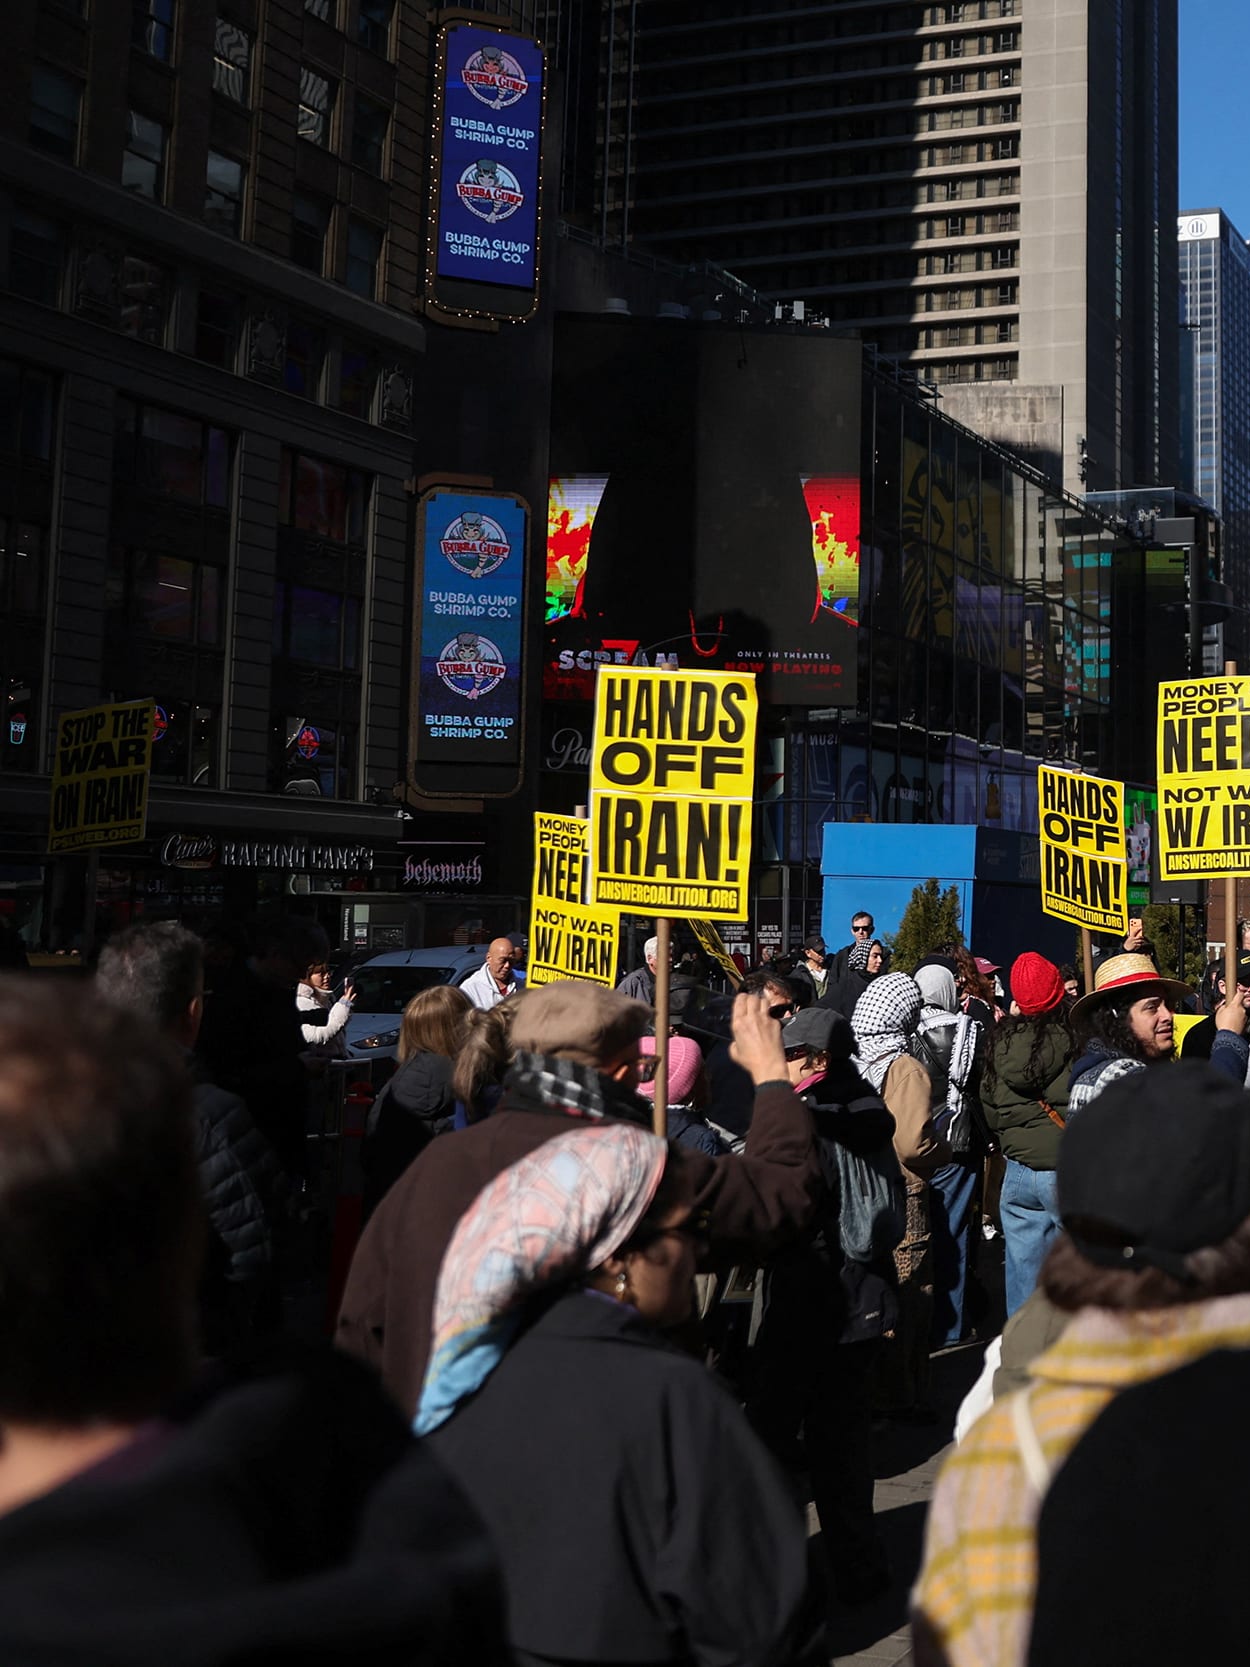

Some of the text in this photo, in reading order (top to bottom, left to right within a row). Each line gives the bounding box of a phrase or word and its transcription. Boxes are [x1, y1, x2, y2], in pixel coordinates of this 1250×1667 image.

[463, 70, 529, 93] BUBBA GUMP
[450, 116, 535, 140] BUBBA GUMP
[455, 129, 529, 151] SHRIMP CO.
[459, 184, 523, 206] BUBBA GUMP
[445, 231, 530, 254] BUBBA GUMP
[450, 243, 524, 265] SHRIMP CO.
[442, 540, 509, 556] BUBBA GUMP
[429, 591, 517, 607] BUBBA GUMP
[434, 604, 511, 618] SHRIMP CO.
[558, 649, 679, 670] SCREAM
[737, 650, 763, 658] ONLY
[784, 651, 831, 660] THEATRES
[439, 662, 505, 677] BUBBA GUMP
[723, 661, 843, 675] NOW PLAYING
[1164, 682, 1244, 699] MONEY
[425, 714, 514, 728] BUBBA GUMP
[604, 678, 748, 744] HANDS
[61, 707, 150, 748] STOP THE
[430, 727, 508, 740] SHRIMP CO.
[60, 738, 146, 777] WAR
[601, 741, 745, 789] OFF
[54, 773, 144, 831] ON IRAN!
[1043, 771, 1118, 824] HANDS
[1164, 786, 1221, 804] NOT
[52, 825, 139, 848] PSLWEB.ORG
[539, 817, 588, 835] MONEY
[1043, 812, 1120, 852] OFF
[1165, 805, 1210, 849] W/
[164, 834, 216, 866] Cane's
[539, 832, 589, 853] PEOPL
[599, 797, 742, 882] IRAN!
[222, 843, 374, 872] RAISING CANE'S
[402, 854, 483, 886] behemoth
[537, 847, 590, 905] NEE
[1045, 843, 1122, 913] IRAN!
[598, 879, 739, 910] ANSWERCOALITION.ORG
[536, 908, 614, 938] NOT WAR
[1046, 895, 1123, 929] ANSWERCOALITION.ORG
[535, 925, 562, 965] W/
[566, 932, 613, 978] IRAN
